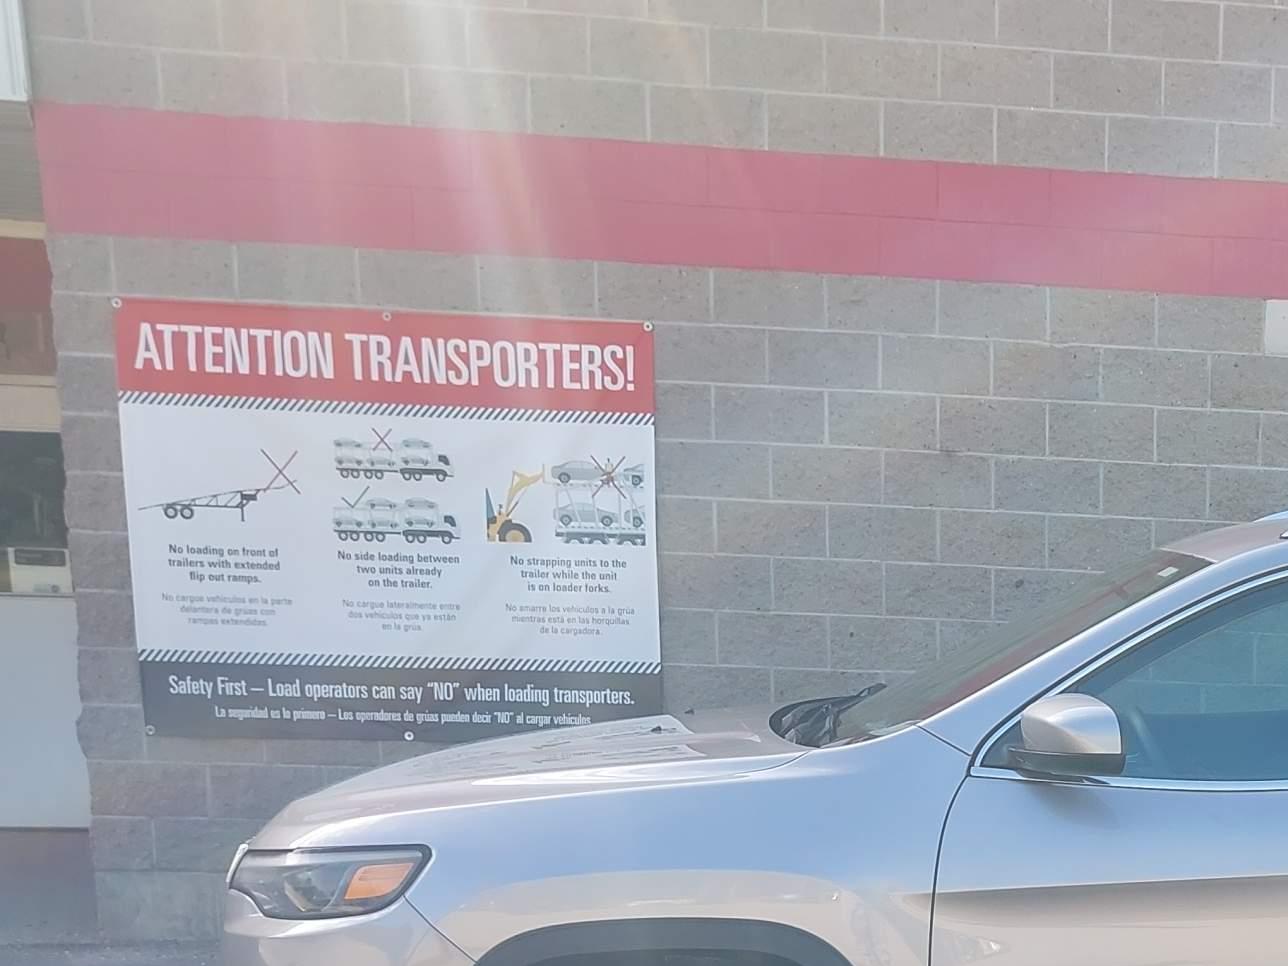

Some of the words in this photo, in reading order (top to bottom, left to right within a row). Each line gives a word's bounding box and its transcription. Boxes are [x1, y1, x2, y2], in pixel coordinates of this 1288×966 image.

[134, 322, 334, 379] ATTENTION
[345, 333, 635, 391] TRANSPORTERS!
[169, 544, 183, 554] No
[187, 545, 224, 557] loading
[228, 548, 239, 556] on
[242, 547, 266, 557] front
[269, 548, 278, 557] of
[338, 551, 351, 559] No
[355, 552, 375, 561] side
[378, 552, 414, 564] loading
[417, 553, 460, 563] between
[510, 556, 524, 565] No
[527, 557, 571, 568] strapping
[575, 558, 597, 567] units
[600, 560, 609, 568] to
[612, 559, 626, 568] the
[168, 558, 205, 568] trailers
[208, 559, 231, 568] with
[234, 561, 280, 570] extended
[190, 572, 205, 582] flip
[208, 573, 225, 581] out
[228, 574, 261, 584] ramps.
[357, 566, 376, 574] two
[379, 566, 402, 575] units
[406, 566, 442, 578] already
[521, 570, 549, 578] trailer
[552, 570, 578, 579] while
[582, 571, 596, 580] the
[599, 571, 617, 580] unit
[383, 578, 398, 588] the
[401, 579, 432, 588] trailer.
[528, 582, 535, 591] is
[553, 583, 582, 592] loader
[585, 584, 610, 592] forks.
[506, 604, 517, 612] No
[608, 606, 615, 614] la
[512, 615, 546, 623] mientras
[579, 616, 589, 624] las
[592, 616, 629, 626] horquillas
[540, 626, 549, 634] de
[552, 626, 558, 634] la
[169, 675, 213, 699] Safety
[217, 677, 248, 696] First
[267, 678, 300, 698] Load
[305, 681, 368, 701] operators
[372, 684, 395, 700] can
[400, 686, 423, 704] say
[464, 683, 500, 701] when
[504, 684, 549, 707] loading
[554, 687, 634, 707] transporters.
[215, 706, 226, 718] La
[293, 709, 325, 721] primero
[339, 708, 353, 720] Los
[356, 709, 400, 723] operadores
[404, 710, 414, 721] de
[441, 712, 469, 724] pueden
[472, 711, 491, 723] decir
[516, 712, 524, 723] al
[526, 713, 551, 727] cargar
